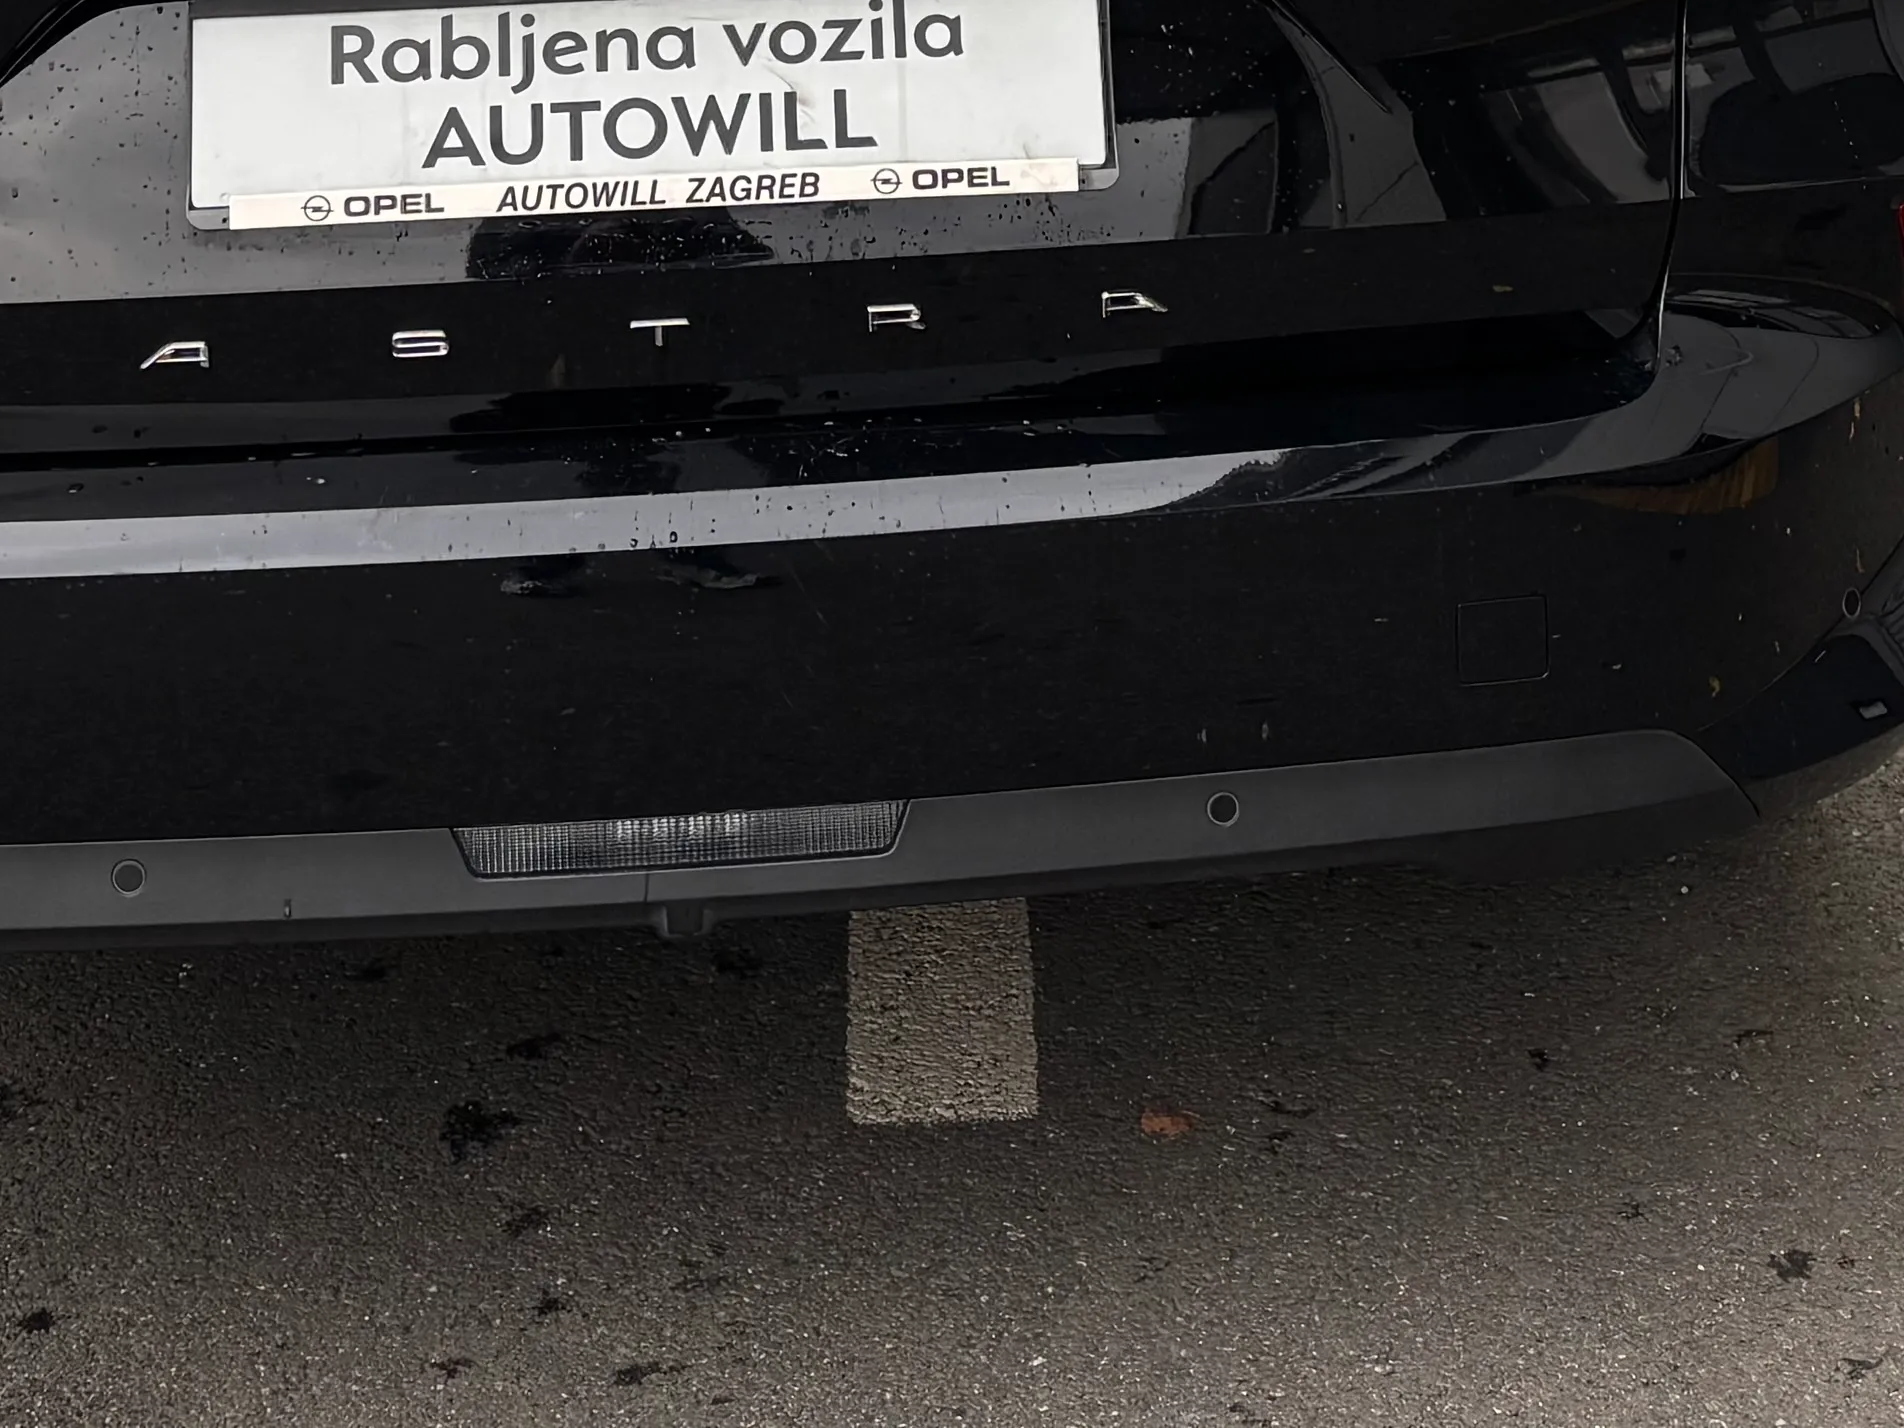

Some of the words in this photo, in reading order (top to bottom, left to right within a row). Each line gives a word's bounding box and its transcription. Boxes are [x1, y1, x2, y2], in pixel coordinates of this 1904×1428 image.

[330, 11, 697, 95] Rabljena
[421, 88, 880, 169] AUTOWILL
[343, 192, 445, 217] OPEL
[496, 178, 667, 213] AUTOWILL
[685, 172, 820, 204] ZAGREB
[912, 166, 1011, 191] OPEL
[140, 288, 1169, 370] ASTRA
